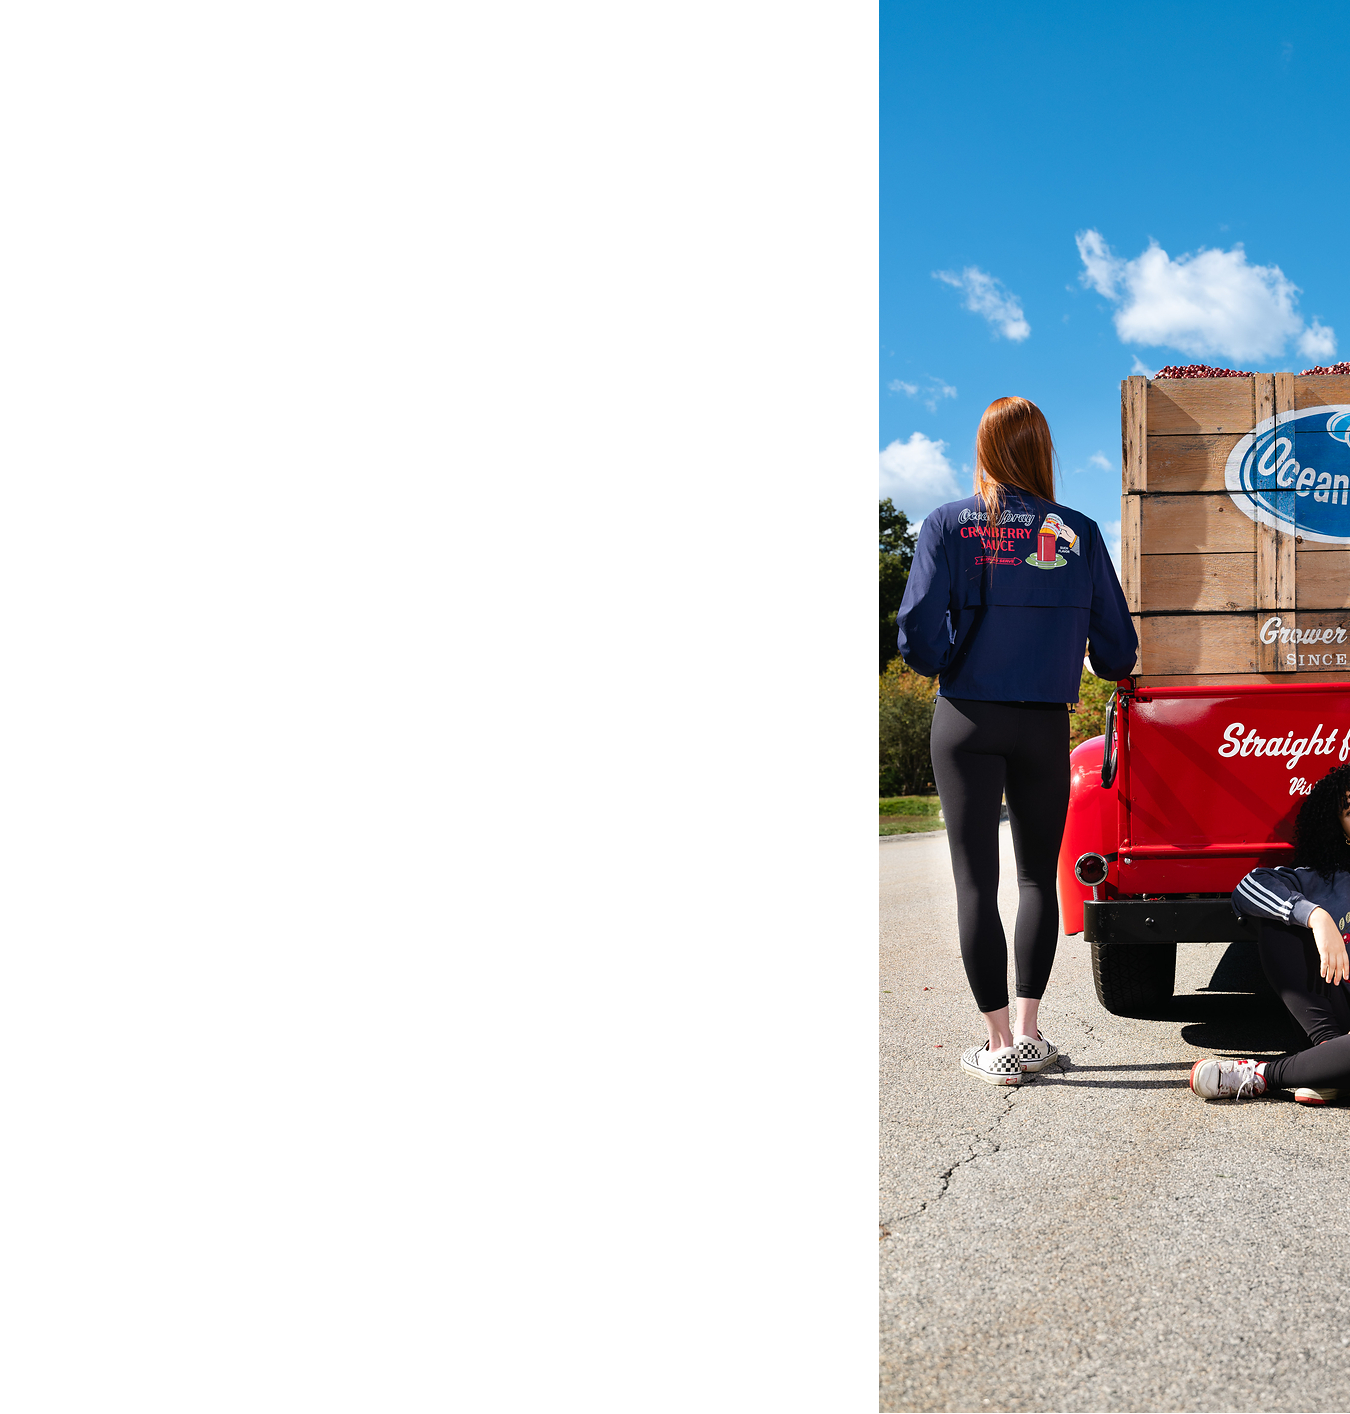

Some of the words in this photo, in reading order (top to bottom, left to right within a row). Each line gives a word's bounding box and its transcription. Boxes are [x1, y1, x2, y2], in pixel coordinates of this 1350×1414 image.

[1257, 436, 1348, 506] Ocean
[960, 526, 1033, 539] CRANBERRY
[981, 538, 1015, 552] SAUCE
[1259, 616, 1348, 645] Grower
[1286, 653, 1347, 666] SINCE
[1218, 722, 1339, 770] Straight
[1289, 776, 1319, 796] Vis
